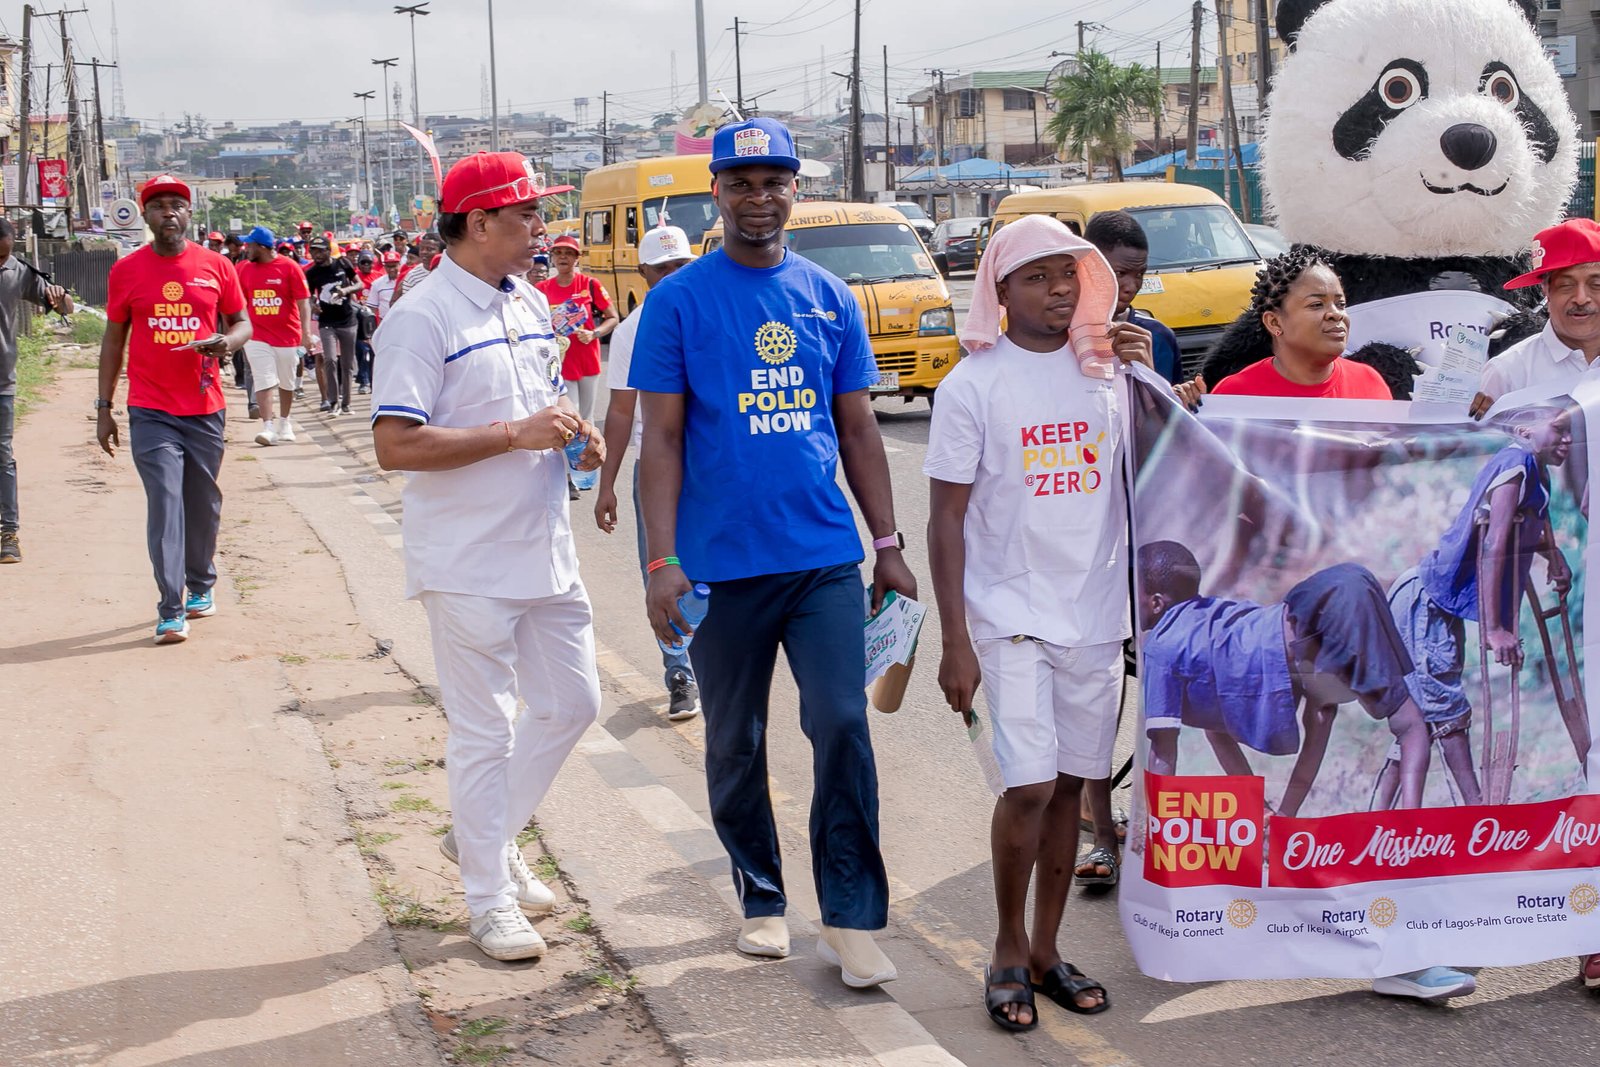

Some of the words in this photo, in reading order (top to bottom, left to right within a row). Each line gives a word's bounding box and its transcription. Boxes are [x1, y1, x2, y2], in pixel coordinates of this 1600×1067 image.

[736, 130, 763, 140] KEEP
[790, 215, 833, 226] UNITED
[252, 297, 283, 307] POLIO
[253, 289, 277, 298] END
[154, 303, 193, 317] END
[255, 306, 280, 315] NOW
[147, 316, 201, 331] POLIO
[153, 330, 196, 345] NOW
[932, 353, 949, 370] God
[750, 366, 804, 390] END
[738, 388, 816, 413] POLIO
[749, 411, 811, 435] NOW
[1021, 421, 1089, 447] KEEP
[1023, 443, 1099, 471] POLIO
[1158, 791, 1238, 819] END
[1148, 817, 1256, 846] POLIO
[1283, 831, 1345, 871] One
[1348, 825, 1456, 867] Mission,
[1467, 817, 1531, 857] One
[1153, 843, 1243, 872] NOW
[1517, 895, 1565, 909] Rotary
[1176, 909, 1224, 924] Rotary
[1322, 909, 1366, 924] Rotary
[1406, 920, 1429, 930] Club
[1431, 919, 1443, 929] of
[1445, 916, 1501, 931] Lagos-Palm
[1503, 914, 1534, 926] Grove
[1537, 912, 1568, 923] Estate
[1133, 913, 1149, 927] Club
[1149, 922, 1158, 931] of
[1158, 924, 1180, 939] Ikeja
[1182, 926, 1224, 938] Connect
[1266, 923, 1290, 933] Club
[1292, 922, 1304, 933] of
[1307, 923, 1331, 935] Ikeja
[1334, 926, 1369, 939] Airport
